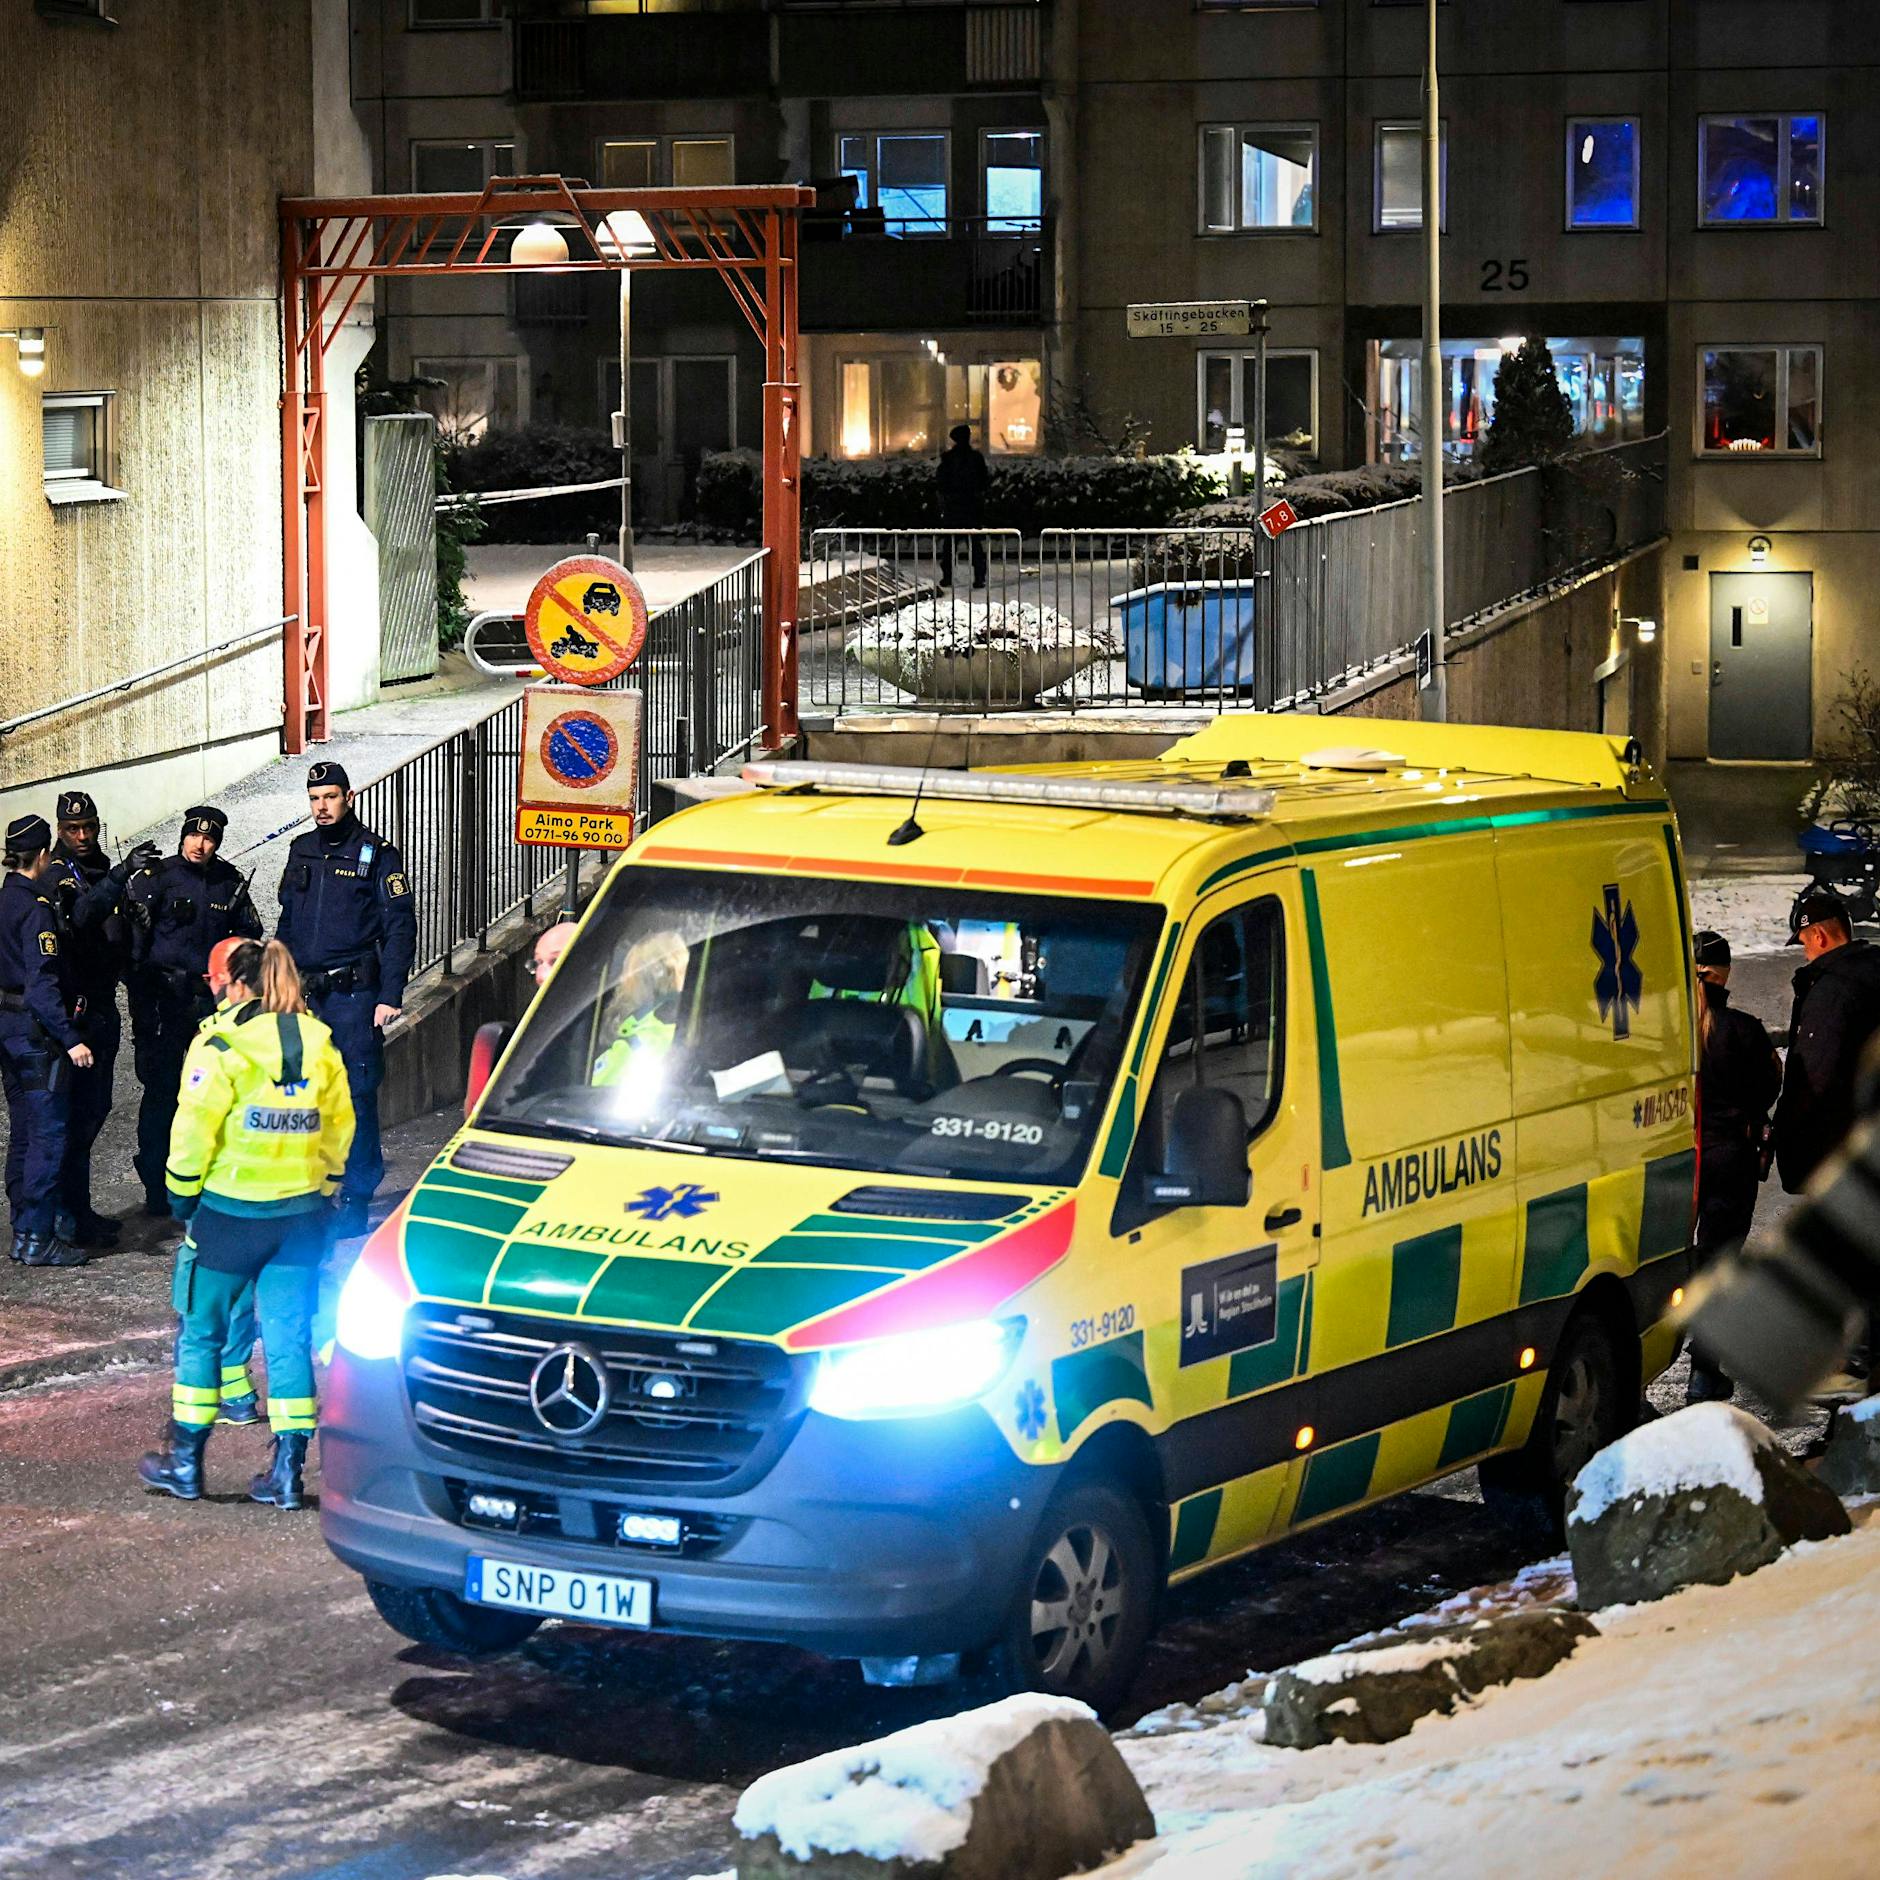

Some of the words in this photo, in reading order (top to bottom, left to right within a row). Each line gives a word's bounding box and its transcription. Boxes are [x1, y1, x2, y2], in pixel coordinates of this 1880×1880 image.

[1481, 259, 1529, 291] 25
[1160, 323, 1173, 333] 15
[1200, 321, 1218, 332] 25
[525, 828, 579, 841] 0771-96
[583, 831, 600, 843] 90
[604, 833, 623, 844] 00
[536, 813, 573, 828] Aimo
[580, 816, 614, 830] Park
[335, 868, 356, 877] POLIS
[931, 1117, 1043, 1145] 331-9120
[1361, 1129, 1502, 1217] AMBULANS
[520, 1221, 750, 1259] AMBULANS
[1071, 1304, 1134, 1348] 331-9120
[496, 1567, 555, 1605] SNP
[569, 1579, 635, 1617] 01W
